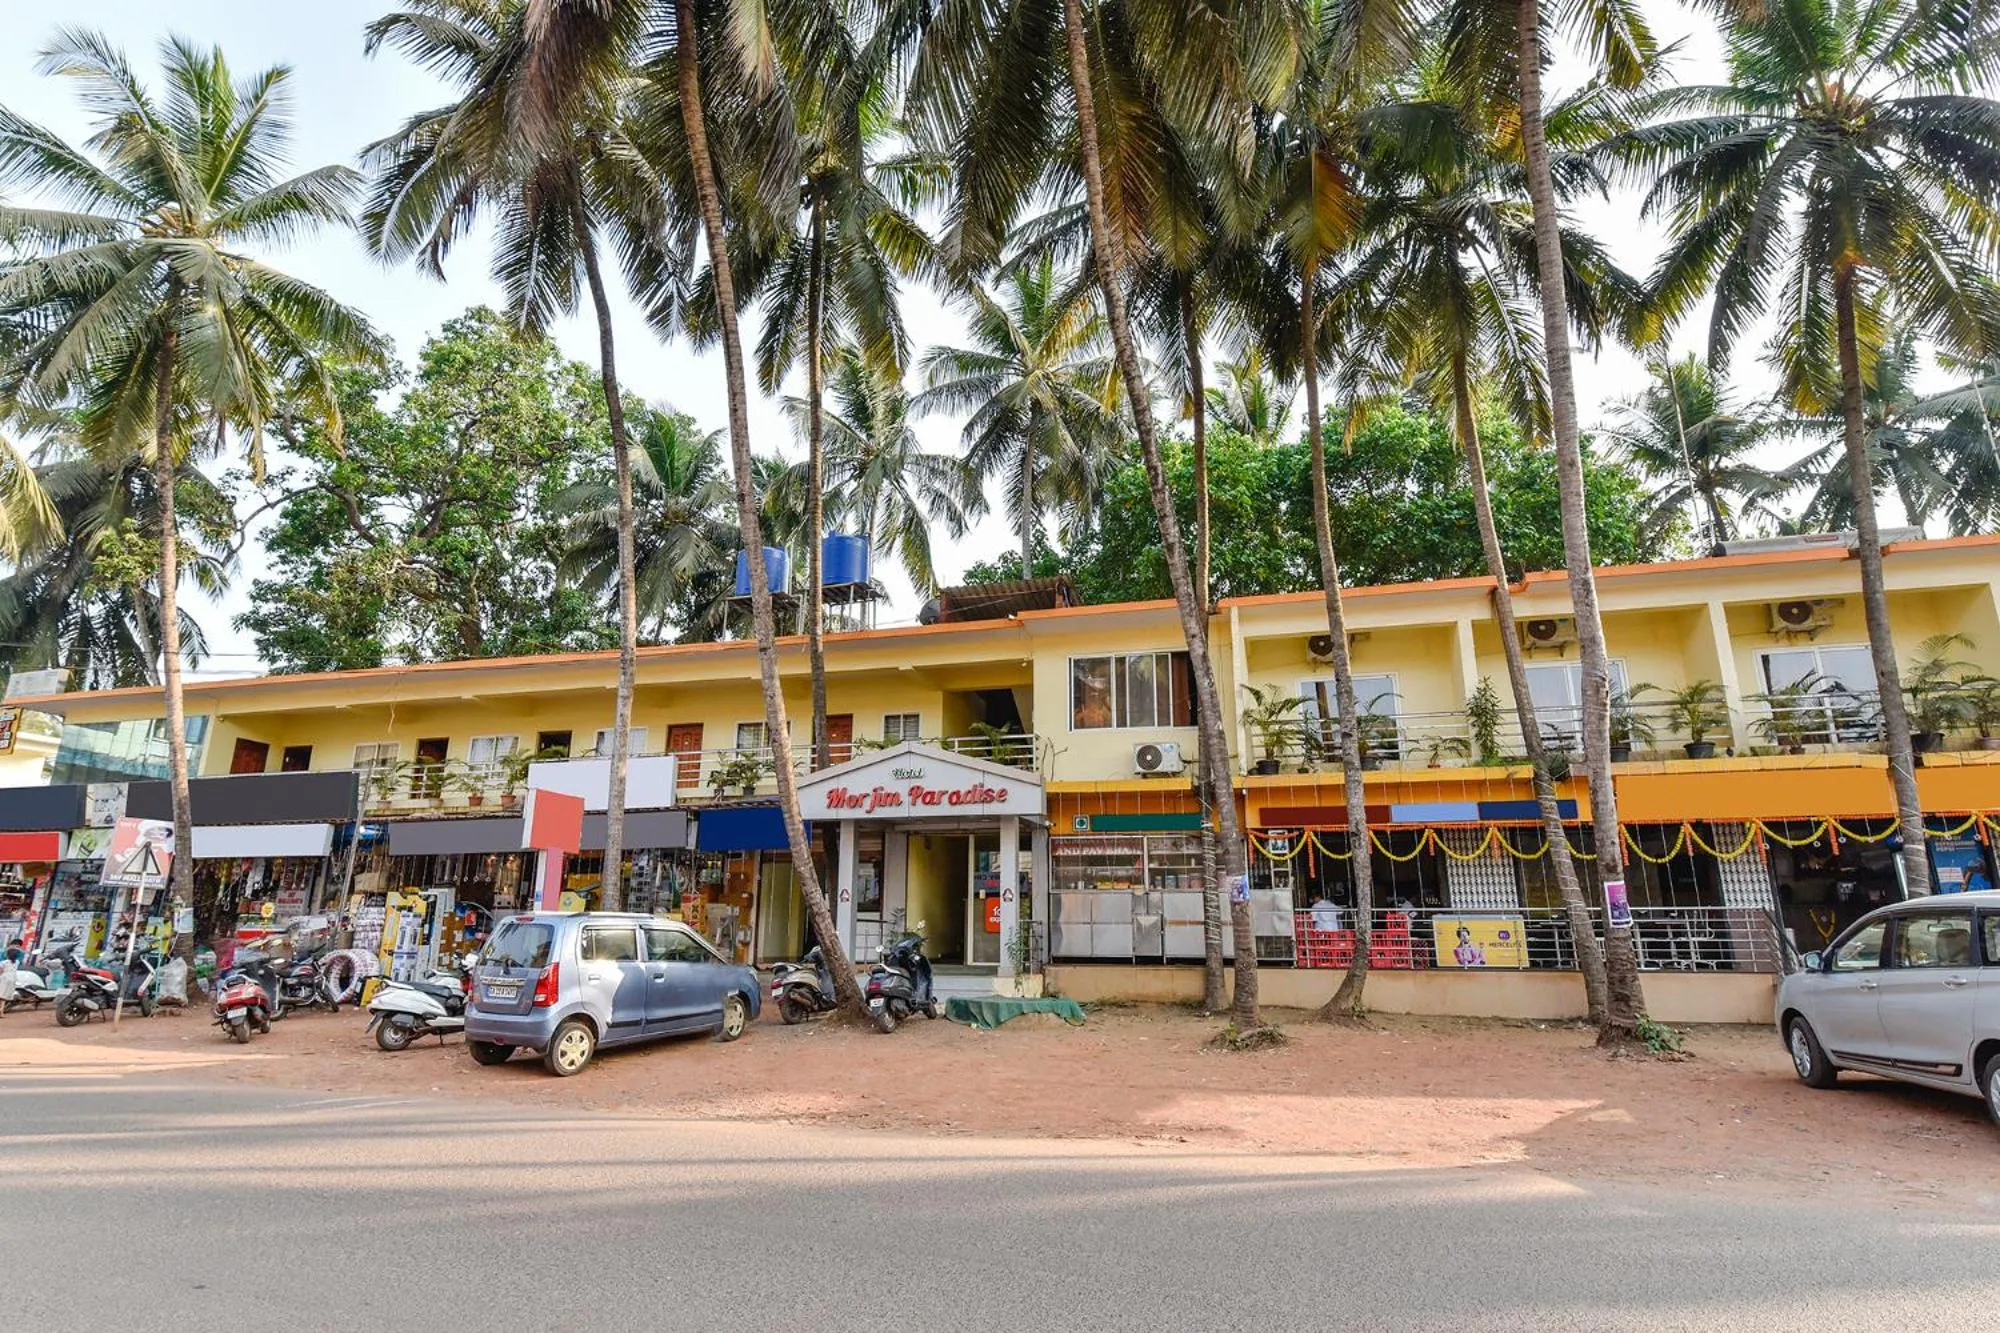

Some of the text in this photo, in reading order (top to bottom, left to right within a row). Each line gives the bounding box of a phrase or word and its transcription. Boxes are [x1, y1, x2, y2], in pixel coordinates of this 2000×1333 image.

[892, 767, 926, 779] Hotel
[826, 782, 1008, 813] Morjim Paradise
[1056, 847, 1081, 856] AND
